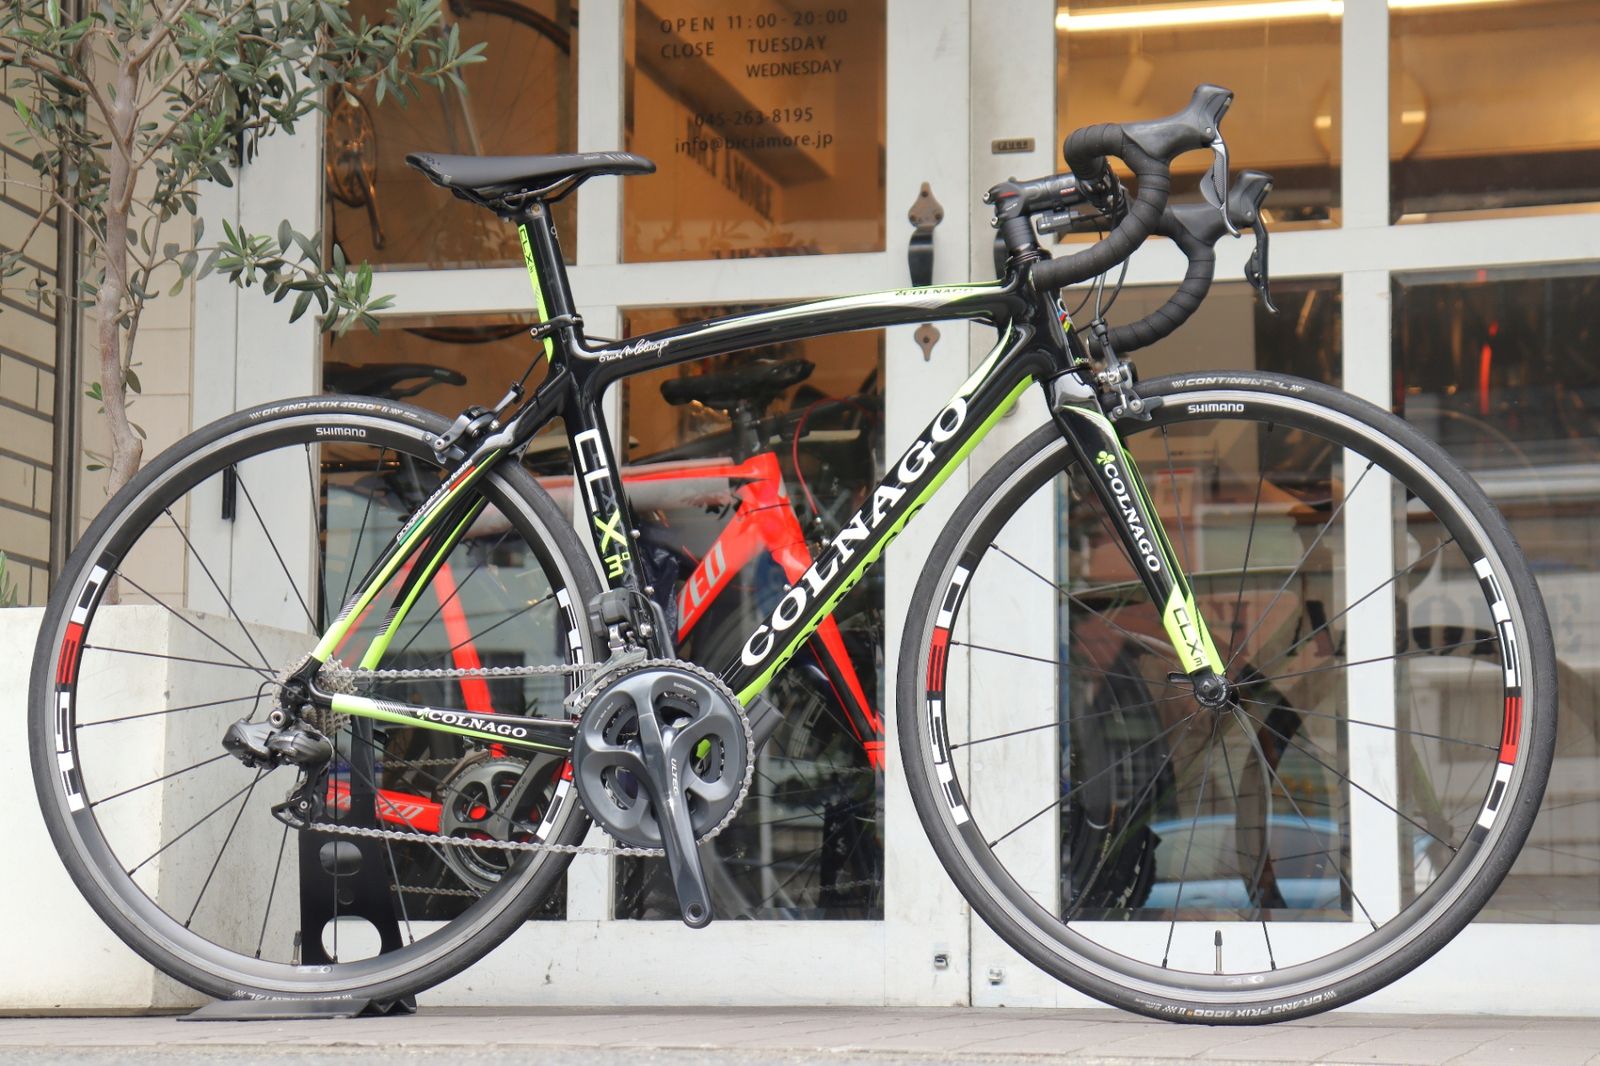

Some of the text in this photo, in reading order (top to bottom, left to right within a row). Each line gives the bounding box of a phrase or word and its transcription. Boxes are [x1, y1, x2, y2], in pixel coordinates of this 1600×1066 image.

[660, 17, 715, 34] OPEN
[661, 35, 827, 59] CLOSE TUESDAY
[746, 59, 842, 78] WEDNESDAY
[1187, 403, 1244, 414] SHIMANO
[315, 427, 367, 438] SHIMANO
[1103, 462, 1161, 572] COLNAGO
[741, 397, 967, 666] COLNAGO
[1172, 606, 1204, 657] CLX
[427, 710, 528, 739] COLNAGO
[1235, 1008, 1272, 1018] PRIX
[1272, 994, 1323, 1013] GRAND
